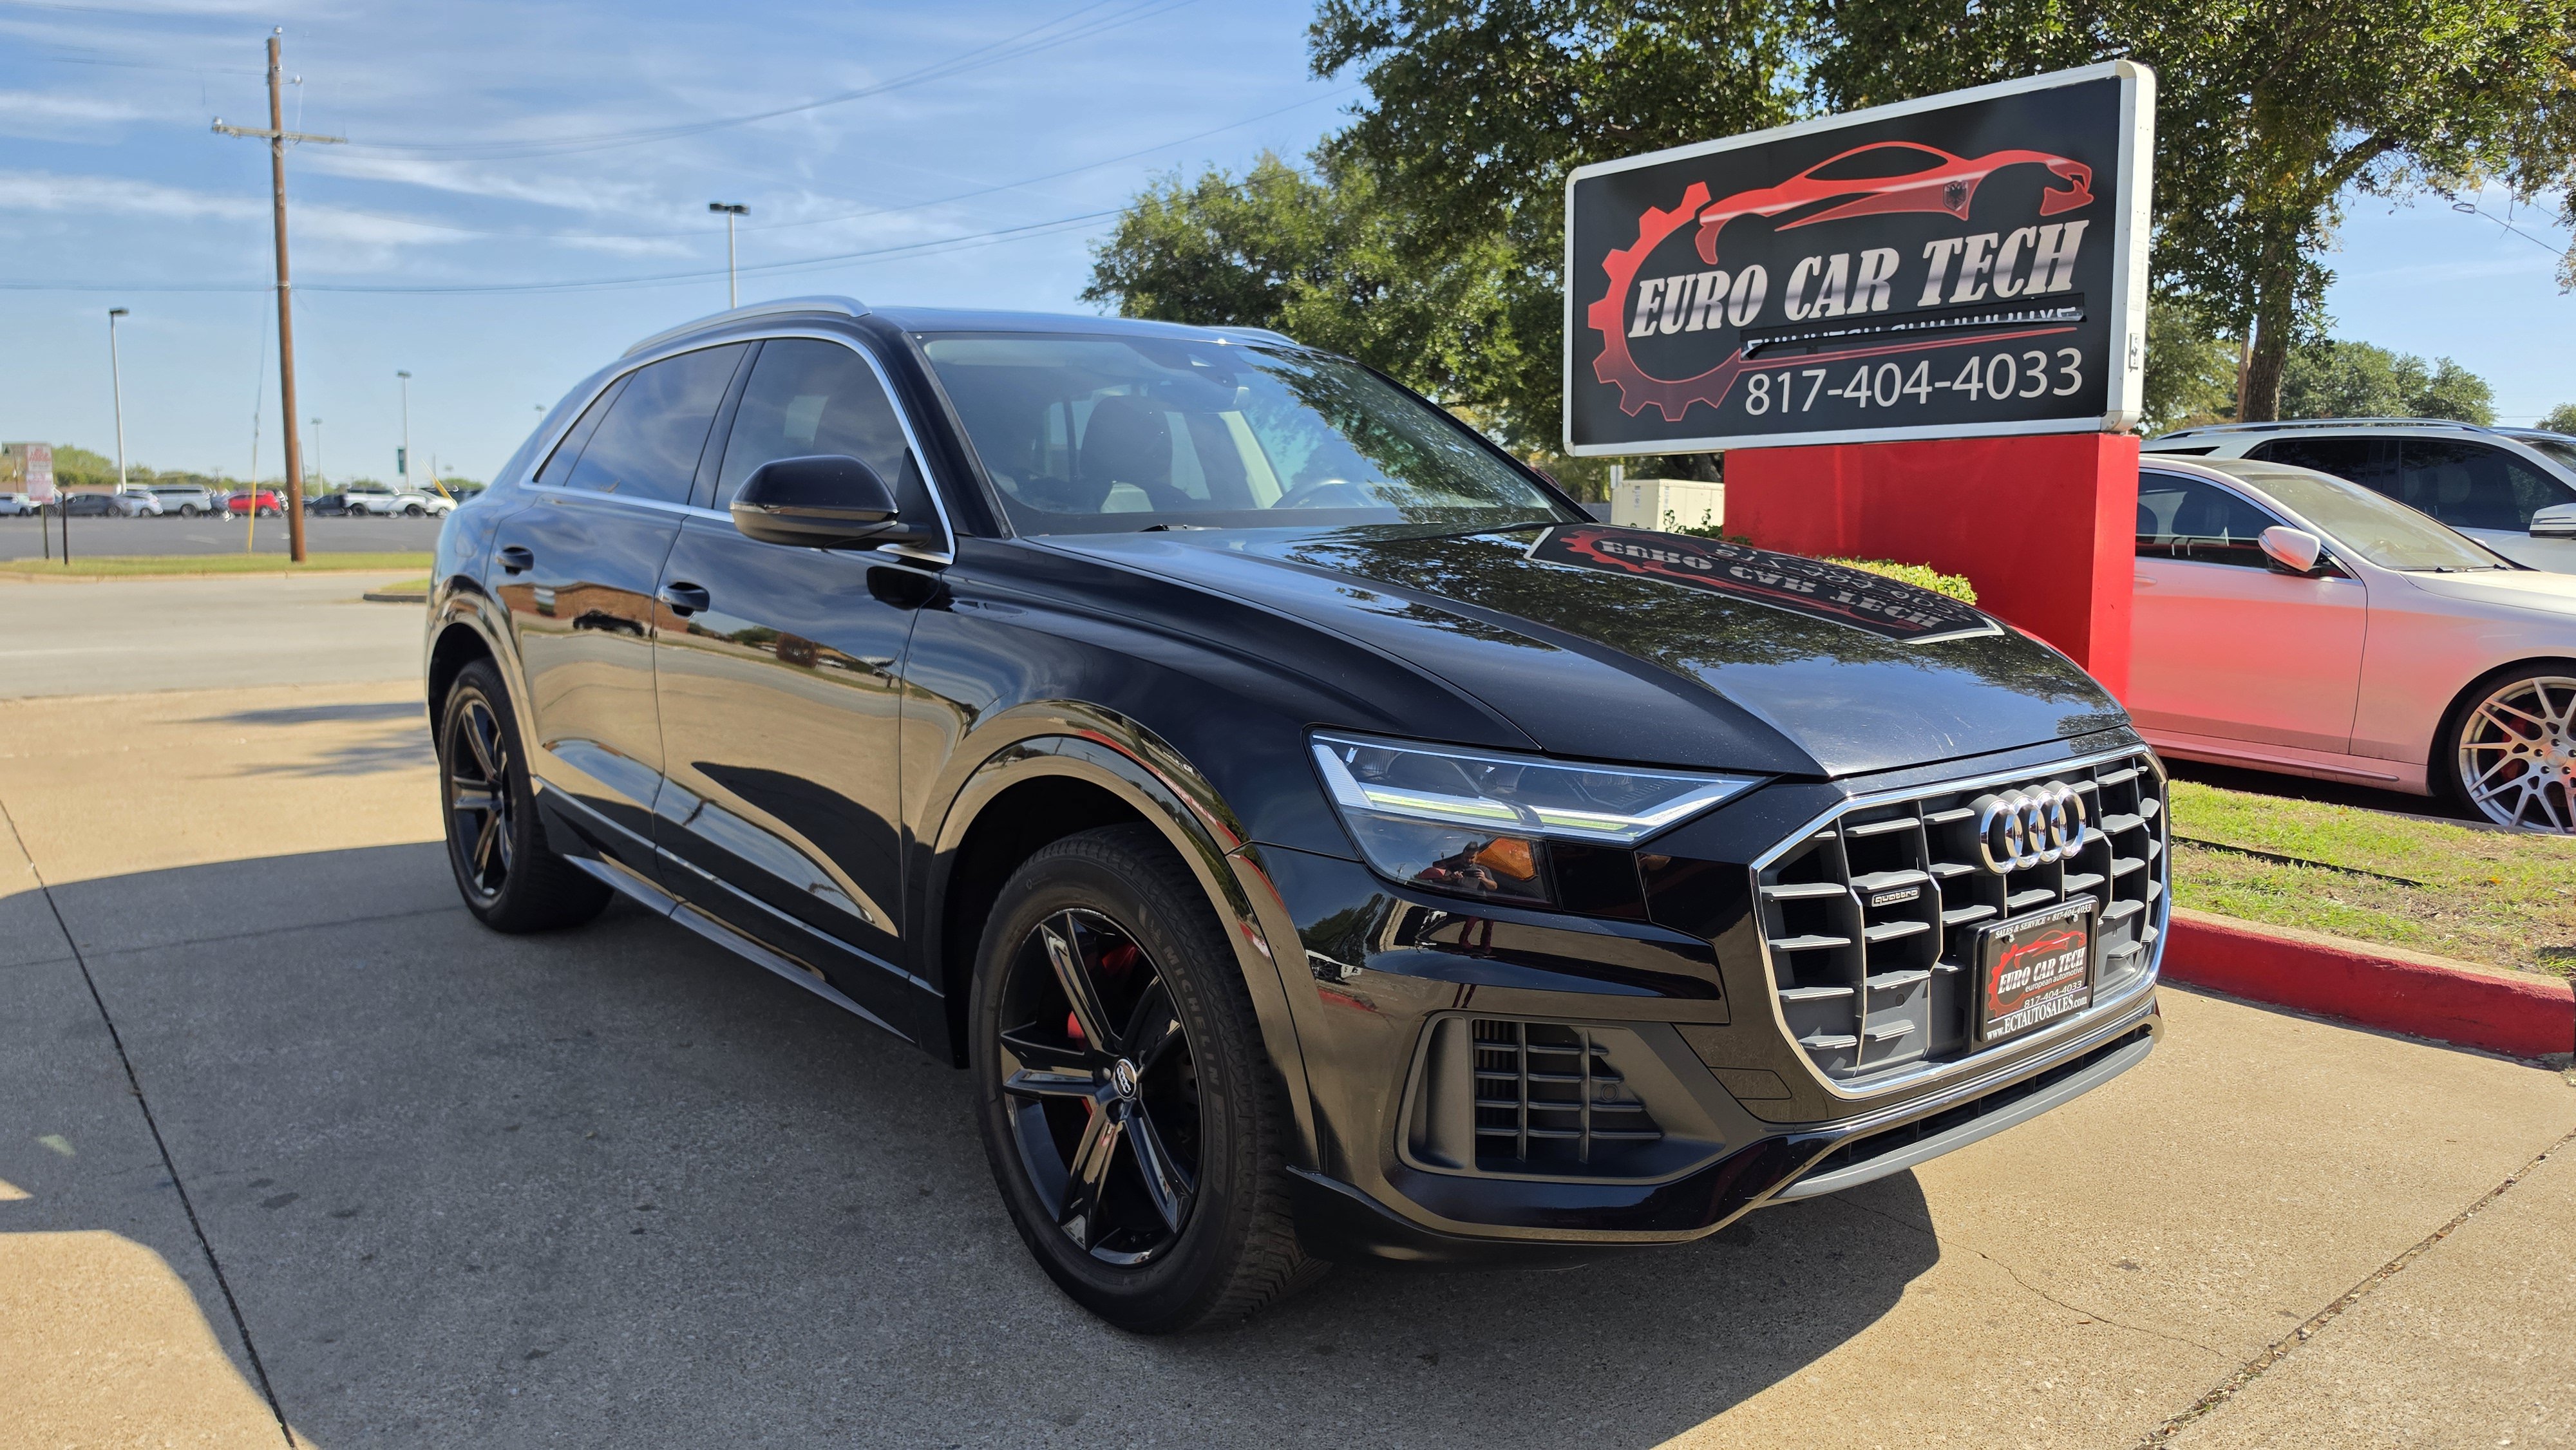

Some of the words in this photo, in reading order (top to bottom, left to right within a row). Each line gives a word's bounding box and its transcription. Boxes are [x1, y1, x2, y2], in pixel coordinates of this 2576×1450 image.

[1628, 264, 1768, 339] EURO
[1784, 247, 1900, 322] CAR
[1918, 220, 2089, 307] TECH
[1745, 346, 2083, 415] 817-404-4033
[1875, 889, 1918, 904] quattro
[1995, 927, 2014, 939] SALES
[2020, 918, 2047, 931] SERVICE
[1997, 966, 2031, 995] EURO
[2034, 957, 2056, 982] CAR
[2058, 946, 2086, 974] TECH
[2025, 977, 2052, 992] european
[2052, 966, 2083, 983] automotive
[2024, 980, 2082, 1008] 817-404-4033
[1163, 946, 1220, 1086] MICHELIN
